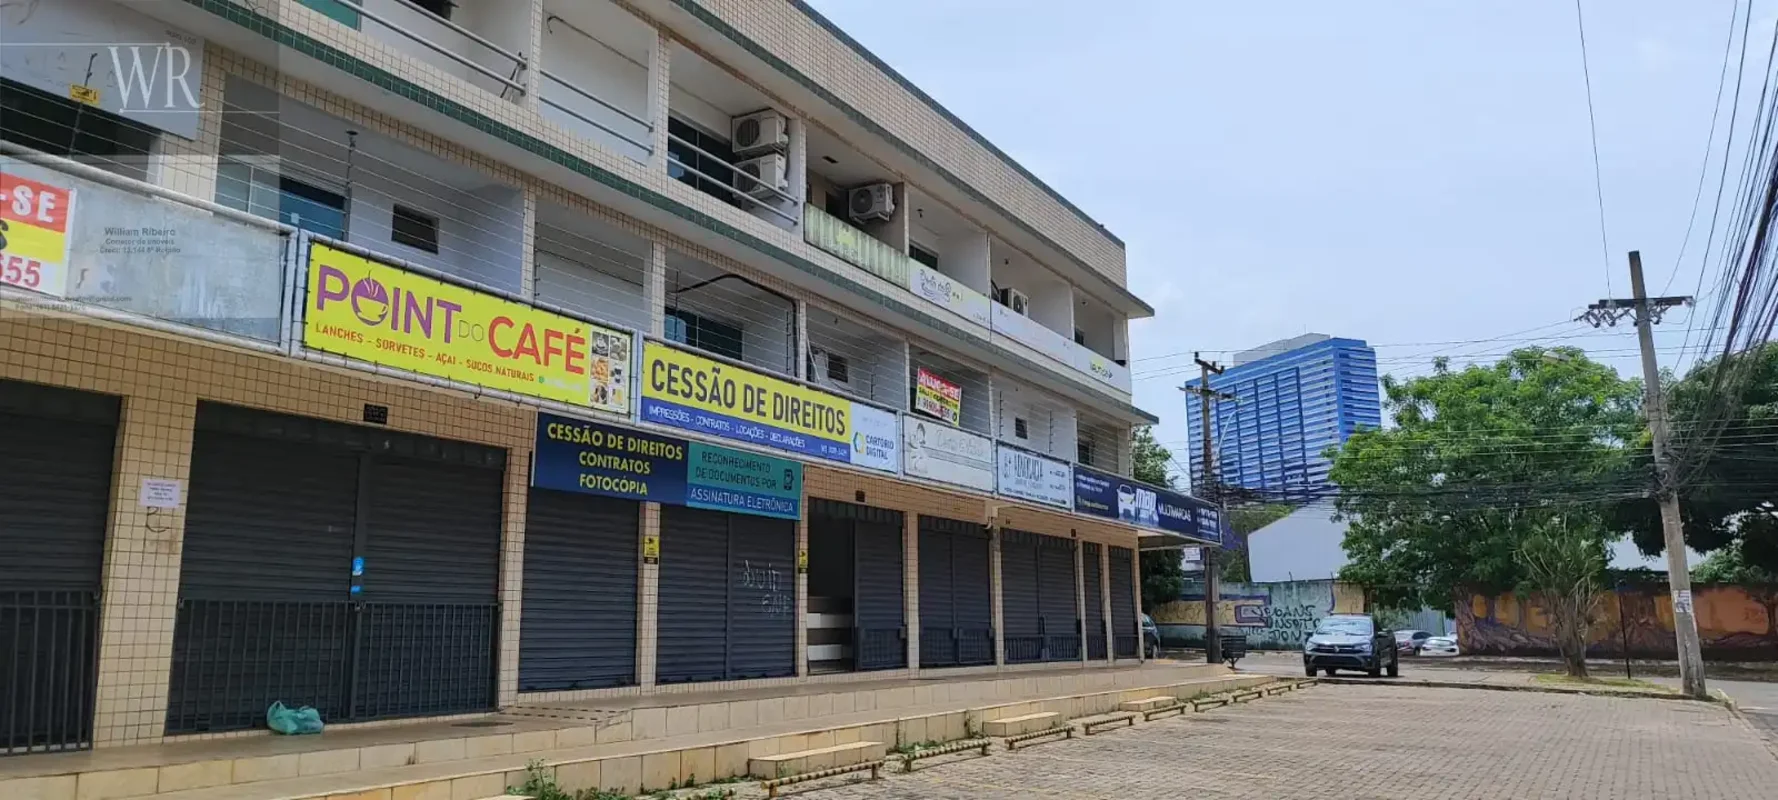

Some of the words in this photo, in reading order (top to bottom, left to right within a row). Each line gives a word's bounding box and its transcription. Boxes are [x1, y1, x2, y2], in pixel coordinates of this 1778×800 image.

[316, 264, 462, 344] POINT
[458, 319, 485, 343] DO
[488, 316, 586, 375] CAFÉ
[316, 320, 364, 344] LANCHES
[376, 338, 425, 359] SORVETES
[466, 358, 493, 373] SUCOS
[496, 365, 535, 382] NATURAIS
[651, 359, 736, 409] CESSÃO
[743, 383, 766, 418] DE
[773, 391, 846, 437] DIREITOS
[695, 415, 731, 432] CONTRATOS
[547, 422, 603, 447] CESSÃO
[607, 433, 624, 450] DE
[627, 437, 683, 460] DIREITOS
[866, 446, 889, 460] DIGITAL
[579, 451, 651, 475] CONTRATOS
[701, 451, 771, 473] RECONHECIMENTO
[579, 473, 648, 496] FOTOCÓPIA
[695, 466, 707, 479] DE
[709, 468, 760, 487] DOCUMENTOS
[762, 477, 777, 490] POR
[690, 487, 745, 508] ASSINATURA
[747, 496, 793, 513] ELETRÔNICA
